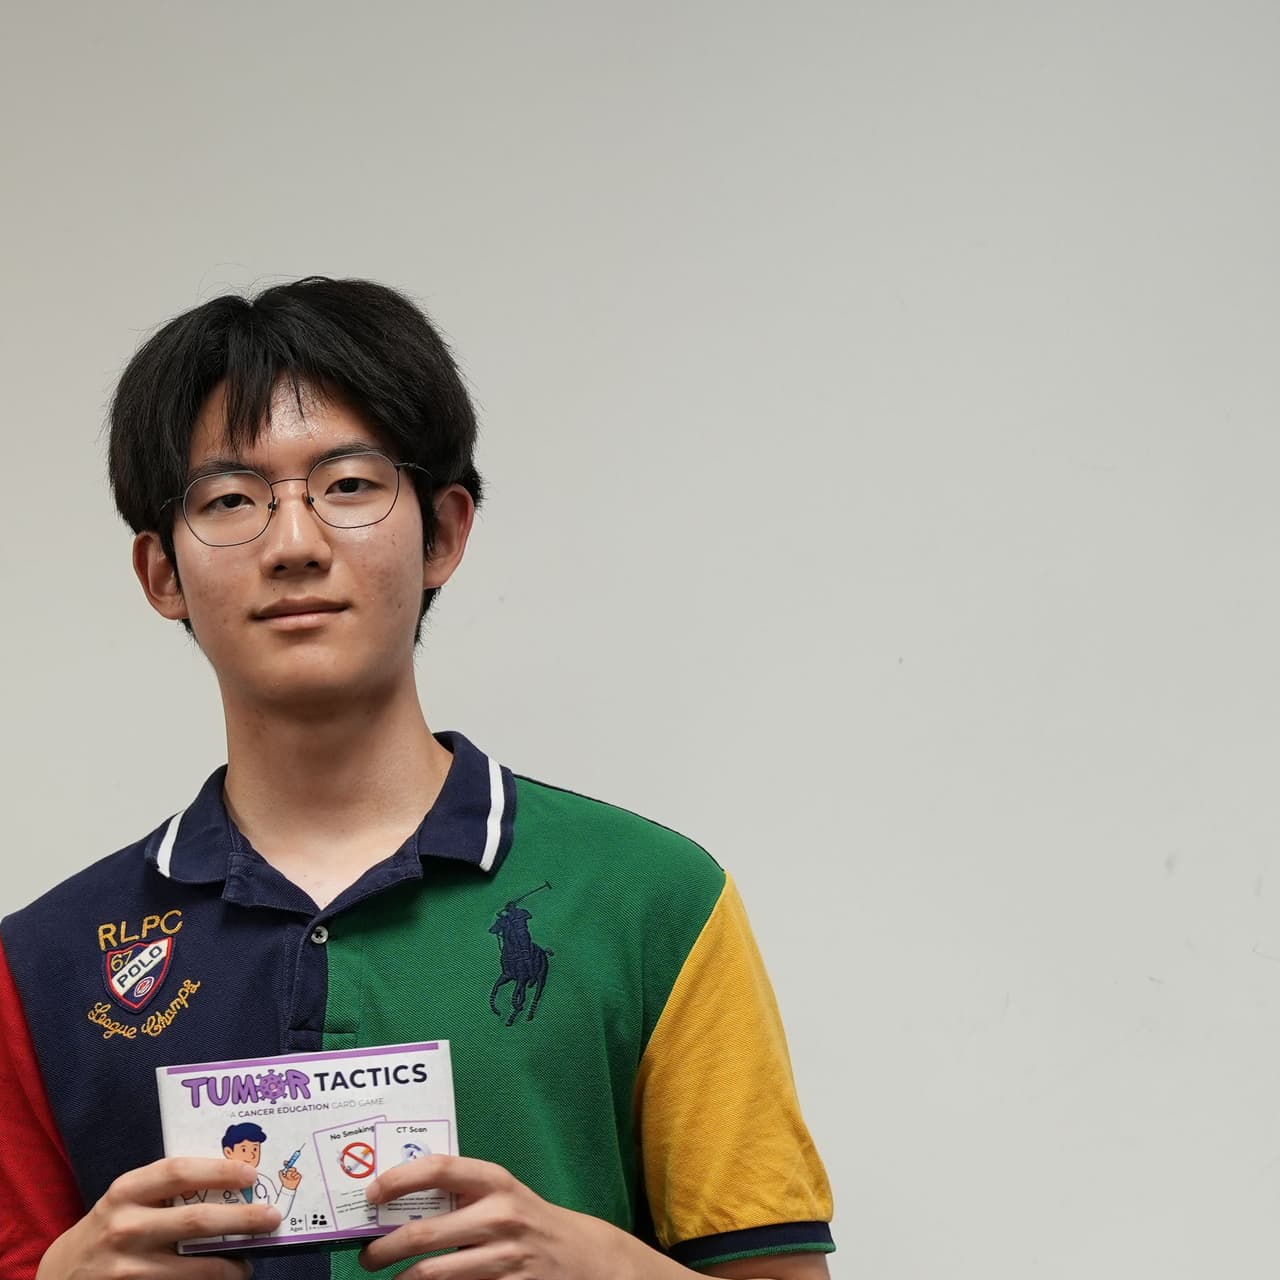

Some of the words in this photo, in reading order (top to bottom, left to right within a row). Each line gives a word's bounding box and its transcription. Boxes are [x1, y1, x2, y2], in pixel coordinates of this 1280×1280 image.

[98, 910, 183, 951] RLPC
[111, 950, 133, 972] 67
[116, 946, 163, 989] POLO
[88, 1002, 137, 1039] League
[182, 1069, 311, 1109] TUMOR
[314, 1063, 428, 1092] TACTICS
[238, 1108, 275, 1118] CANCER
[277, 1103, 329, 1114] EDUCATION
[331, 1100, 356, 1110] CARD
[358, 1097, 384, 1107] GAME
[342, 1125, 375, 1138] Smoking
